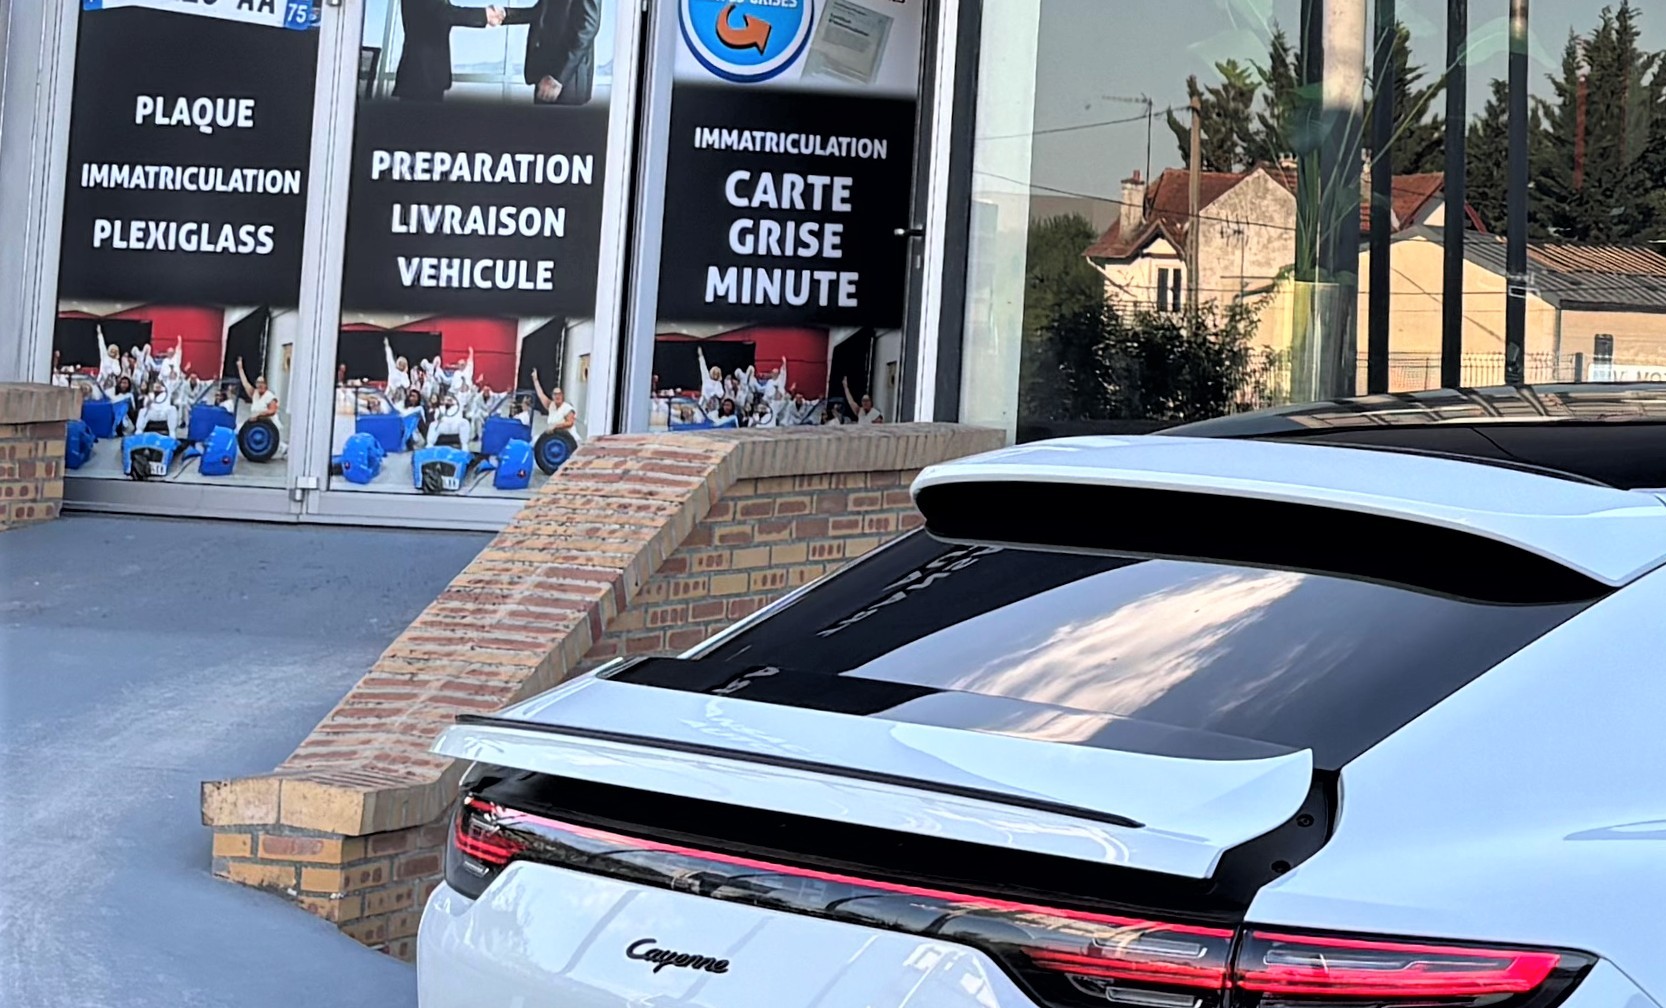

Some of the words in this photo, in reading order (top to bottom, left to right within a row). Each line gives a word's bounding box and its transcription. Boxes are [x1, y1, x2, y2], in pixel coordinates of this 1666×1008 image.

[287, 3, 307, 23] 75
[134, 96, 256, 134] PLAQUE
[694, 126, 888, 160] IMMATRICULATION
[80, 163, 301, 195] IMMATRICULATION
[371, 150, 594, 185] PREPARATION
[725, 169, 853, 212] CARTE
[92, 219, 275, 256] PLEXIGLASS
[391, 203, 566, 238] LIVRAISON
[728, 218, 844, 258] GRISE
[396, 256, 555, 291] VEHICULE
[705, 265, 859, 307] MINUTE
[626, 938, 730, 974] Cayenne
